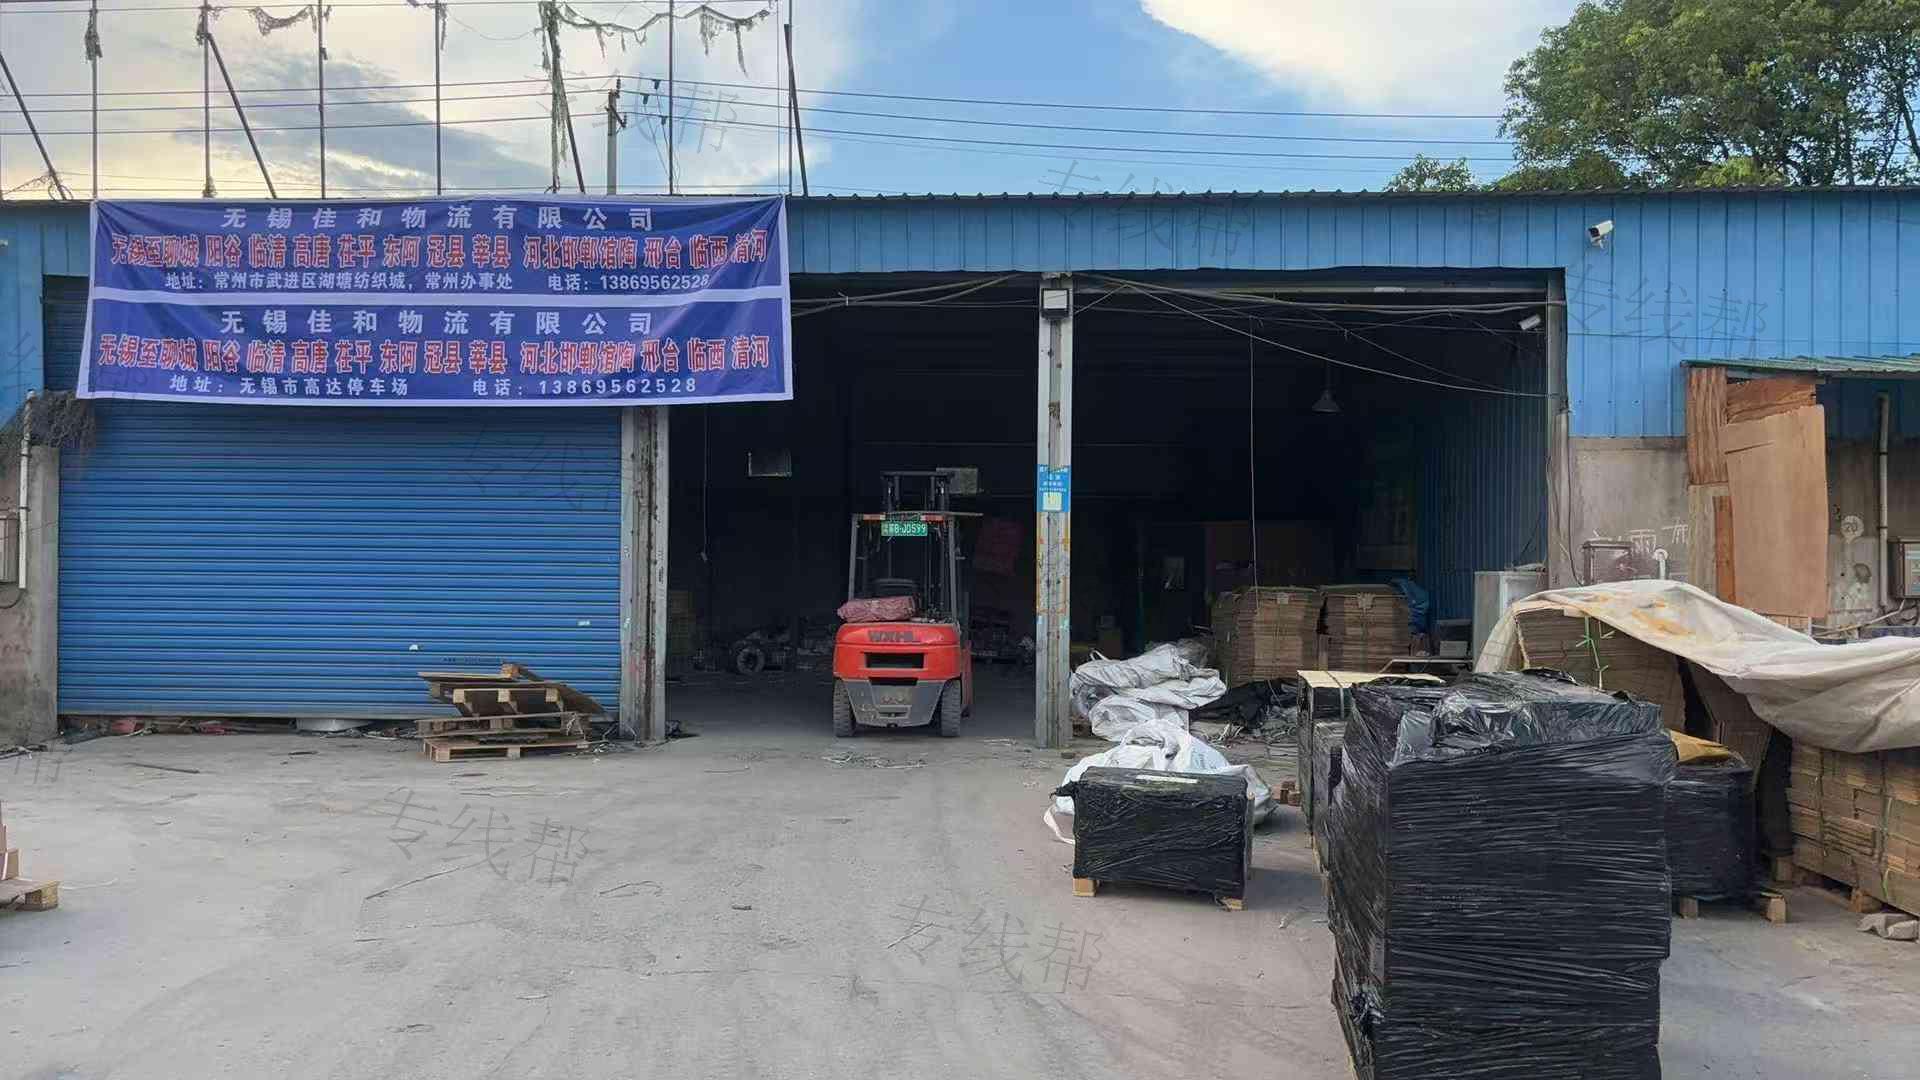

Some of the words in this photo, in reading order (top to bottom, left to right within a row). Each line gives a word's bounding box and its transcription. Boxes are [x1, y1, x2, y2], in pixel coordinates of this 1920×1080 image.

[223, 206, 653, 232] 无锡佳和物流有限公司
[205, 234, 242, 268] 阳谷
[248, 233, 286, 269] 临清
[293, 234, 331, 268] 高唐
[336, 234, 376, 268] 茌平
[383, 234, 421, 268] 东阿
[427, 234, 465, 268] 冠县
[472, 234, 511, 269] 莘县
[523, 235, 638, 270] 河北邯郸馆陶
[644, 236, 682, 269] 邢台
[689, 234, 729, 268] 临西
[220, 310, 652, 335] 无锡佳和物流有限公司
[98, 334, 198, 372] 无锡至聊城
[203, 339, 241, 373] 阳谷
[246, 340, 285, 374] 临清
[291, 339, 328, 374] 高唐
[335, 340, 374, 374] 茌平
[379, 339, 417, 374] 东阿
[424, 340, 461, 374] 冠县
[469, 340, 506, 374] 莘县
[520, 340, 636, 375] 河北邯郸馆陶
[640, 337, 680, 373] 邢台
[687, 338, 726, 371] 临西
[731, 334, 769, 369] 清河
